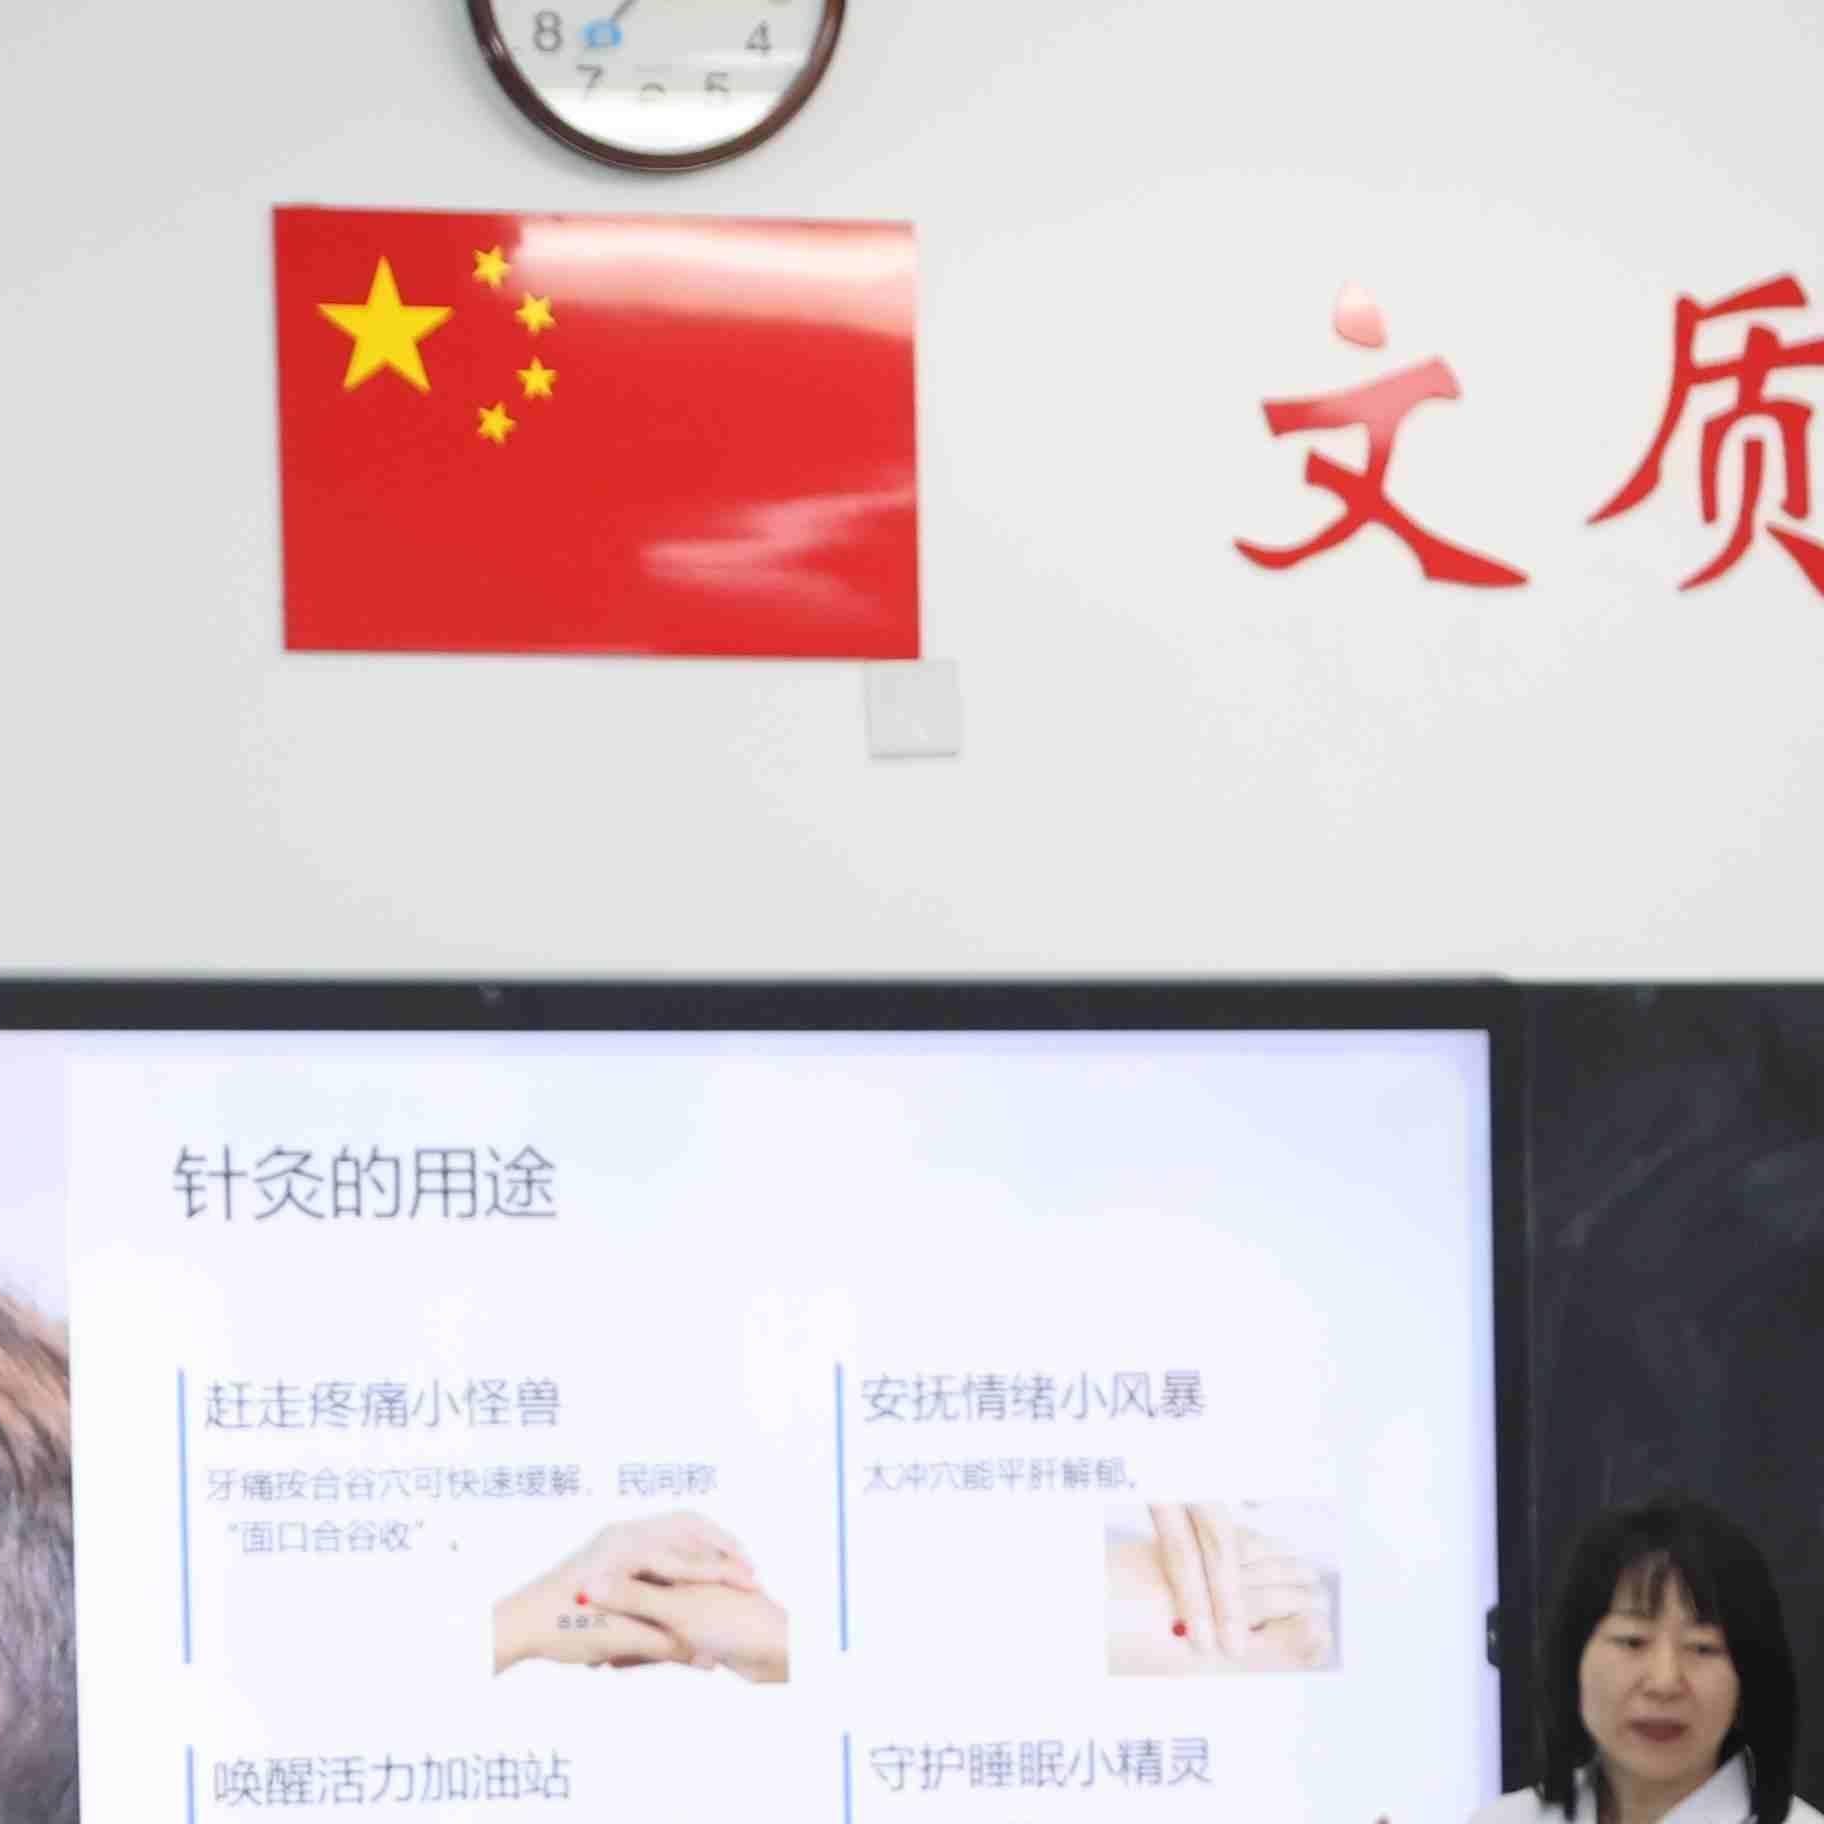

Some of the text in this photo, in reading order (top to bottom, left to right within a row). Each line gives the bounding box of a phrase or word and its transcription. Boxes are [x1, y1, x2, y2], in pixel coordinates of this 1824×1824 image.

[532, 11, 563, 52] 8
[745, 21, 773, 56] 4
[171, 1142, 561, 1223] 针灸的用途
[202, 1376, 564, 1430] 赶走疼痛小怪兽
[859, 1369, 1208, 1424] 安抚情绪小风暴
[212, 1749, 573, 1807] 唤醒活力加油站
[868, 1736, 1214, 1792] 守护睡眠小精灵
